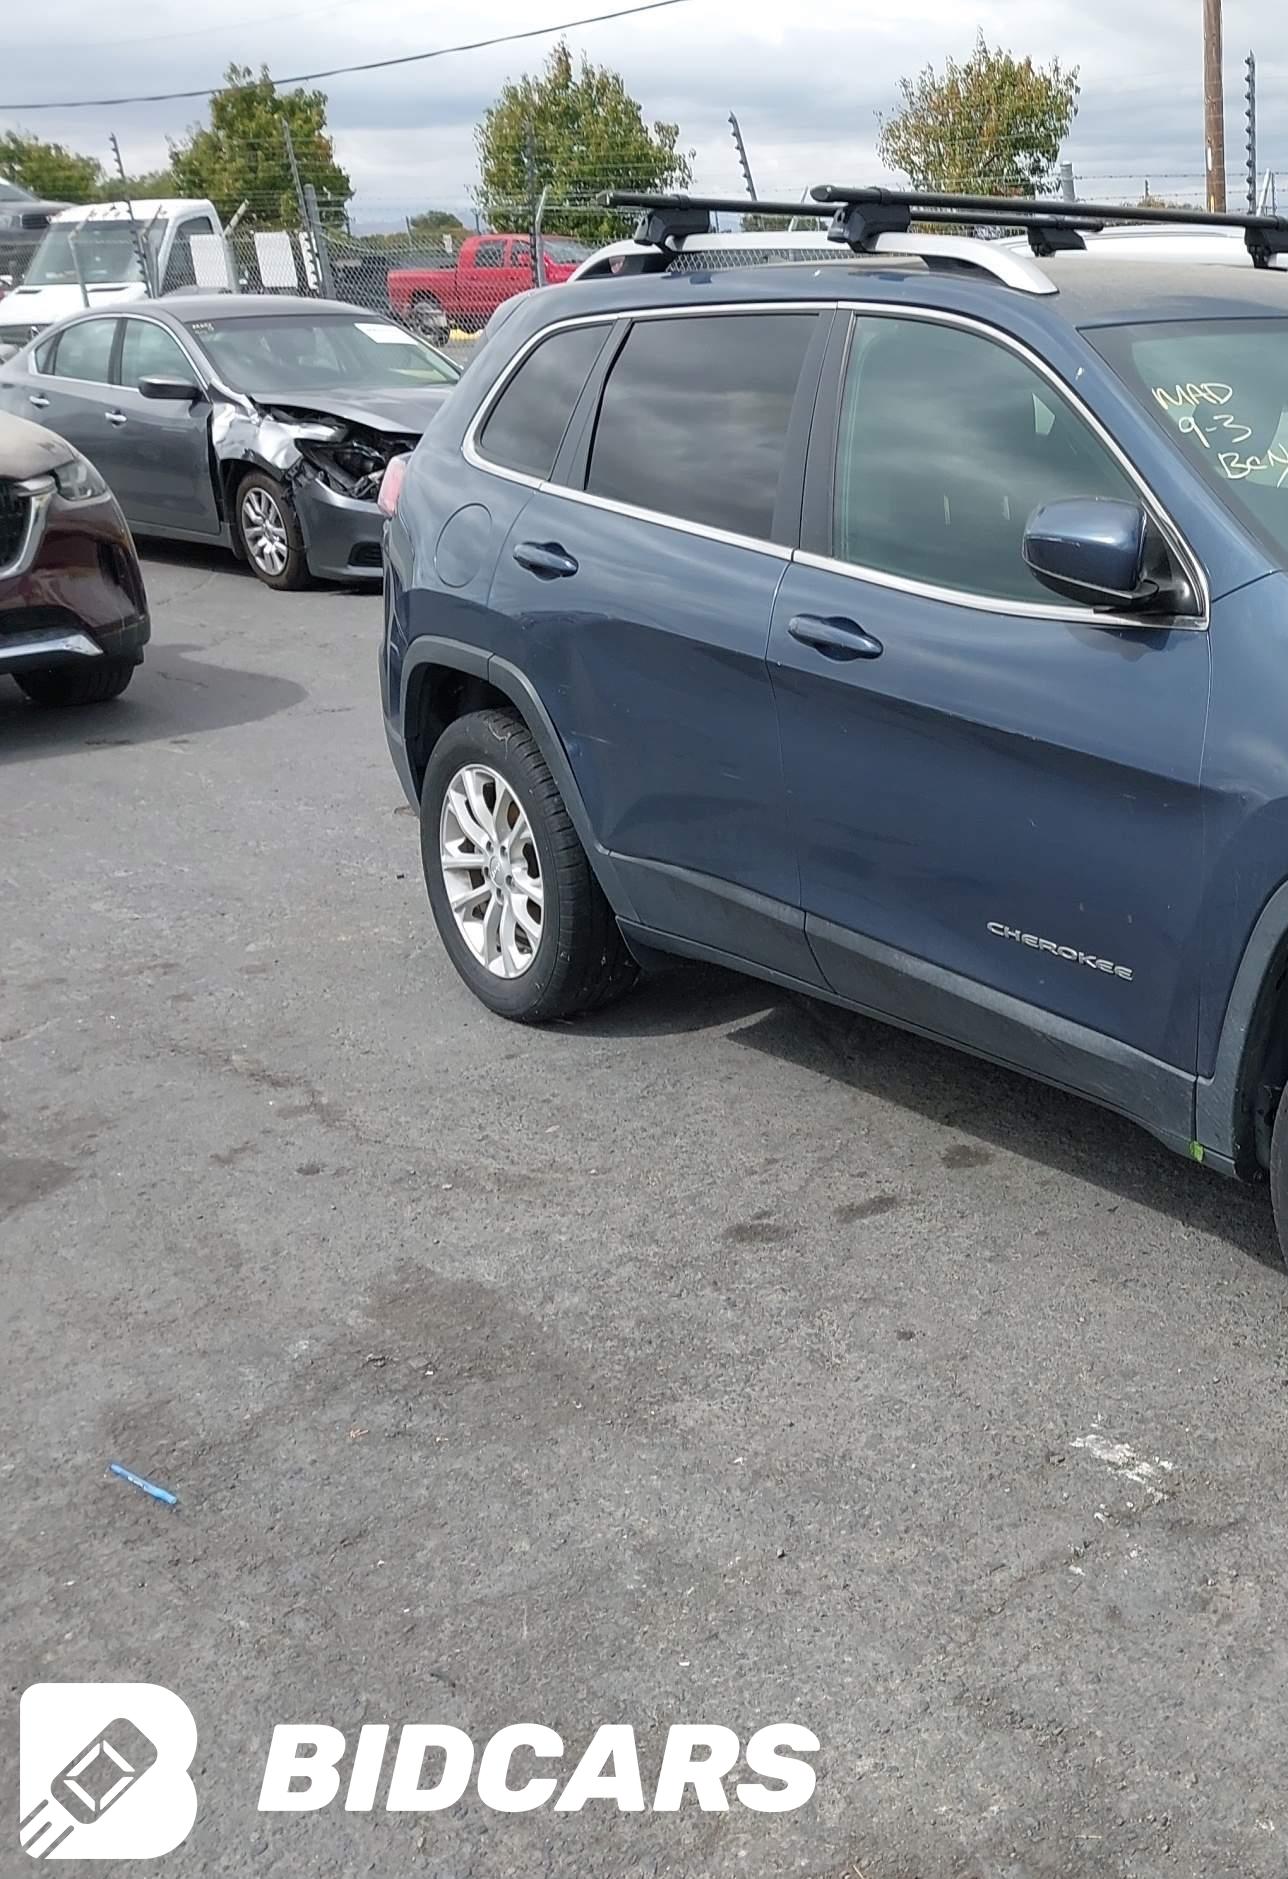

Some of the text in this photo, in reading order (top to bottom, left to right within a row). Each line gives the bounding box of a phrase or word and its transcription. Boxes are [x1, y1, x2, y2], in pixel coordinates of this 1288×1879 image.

[1151, 382, 1233, 410] MAD
[1178, 414, 1252, 448] 9-3
[986, 921, 1134, 981] CHEROKEE
